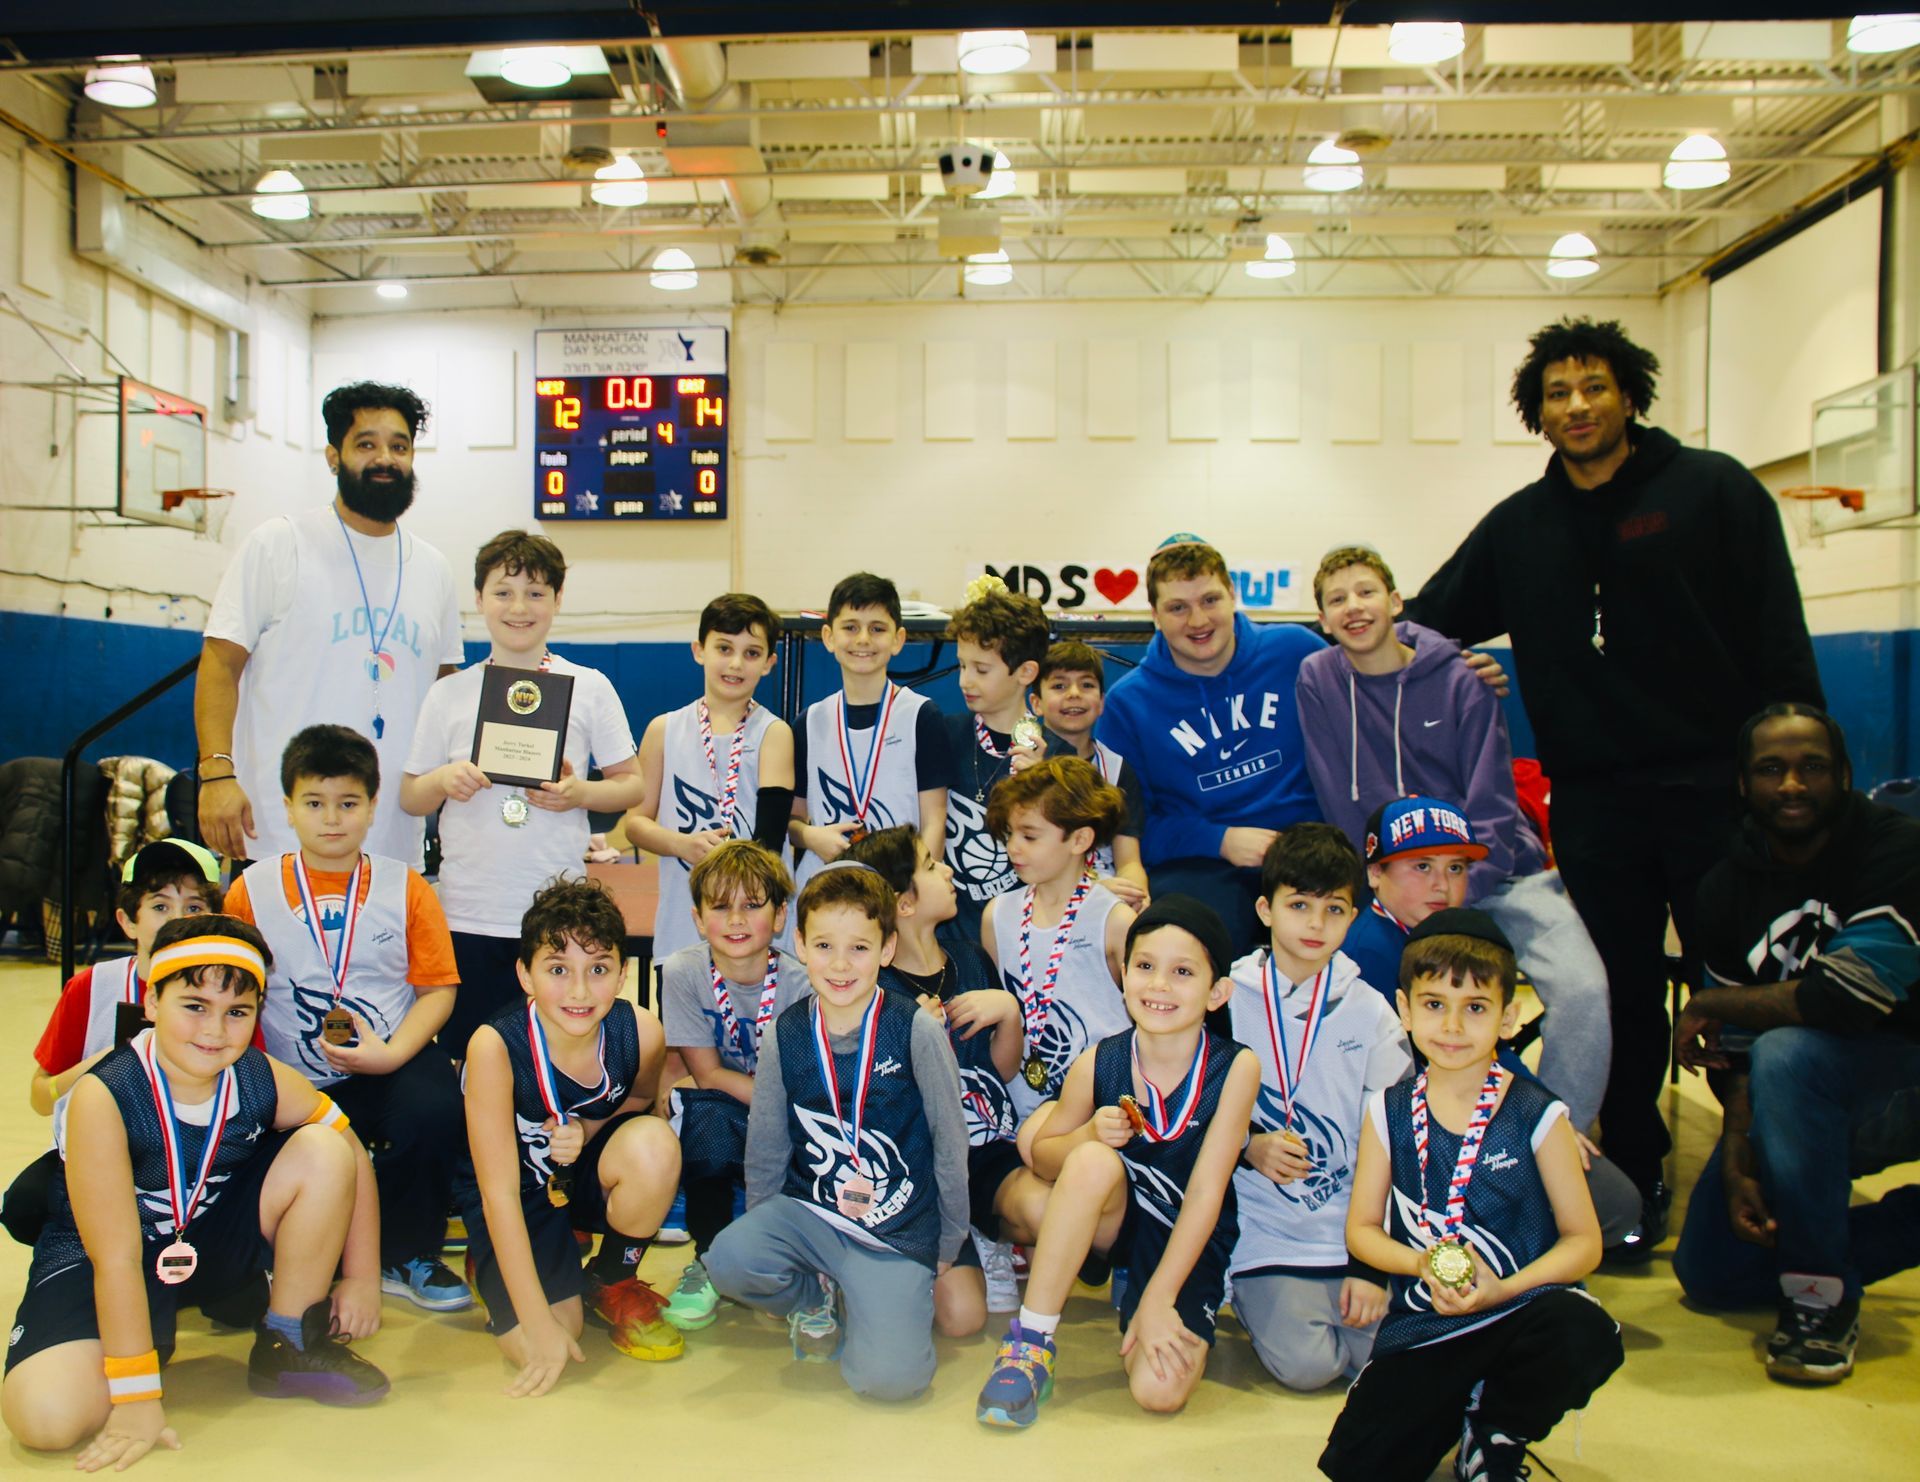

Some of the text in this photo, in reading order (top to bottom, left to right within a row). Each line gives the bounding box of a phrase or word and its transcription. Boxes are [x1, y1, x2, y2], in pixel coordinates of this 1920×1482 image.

[563, 332, 649, 343] MANHATTAN
[563, 343, 647, 356] DAY SCHOOL
[607, 378, 652, 409] 0.0
[555, 397, 581, 429] 12
[696, 397, 723, 427] 14
[611, 427, 648, 445] period
[657, 422, 673, 445] 4
[610, 449, 648, 467] player
[548, 471, 564, 495] 0
[699, 469, 716, 494] 0
[613, 501, 644, 516] game
[330, 605, 423, 659] LOCAL
[1169, 691, 1280, 757] NIKE
[1215, 758, 1267, 784] TENNIS
[1389, 807, 1471, 847] NEW YORK
[966, 868, 1019, 901] BLAZER
[1490, 1157, 1519, 1172] Hoops
[861, 1177, 915, 1229] AZERS
